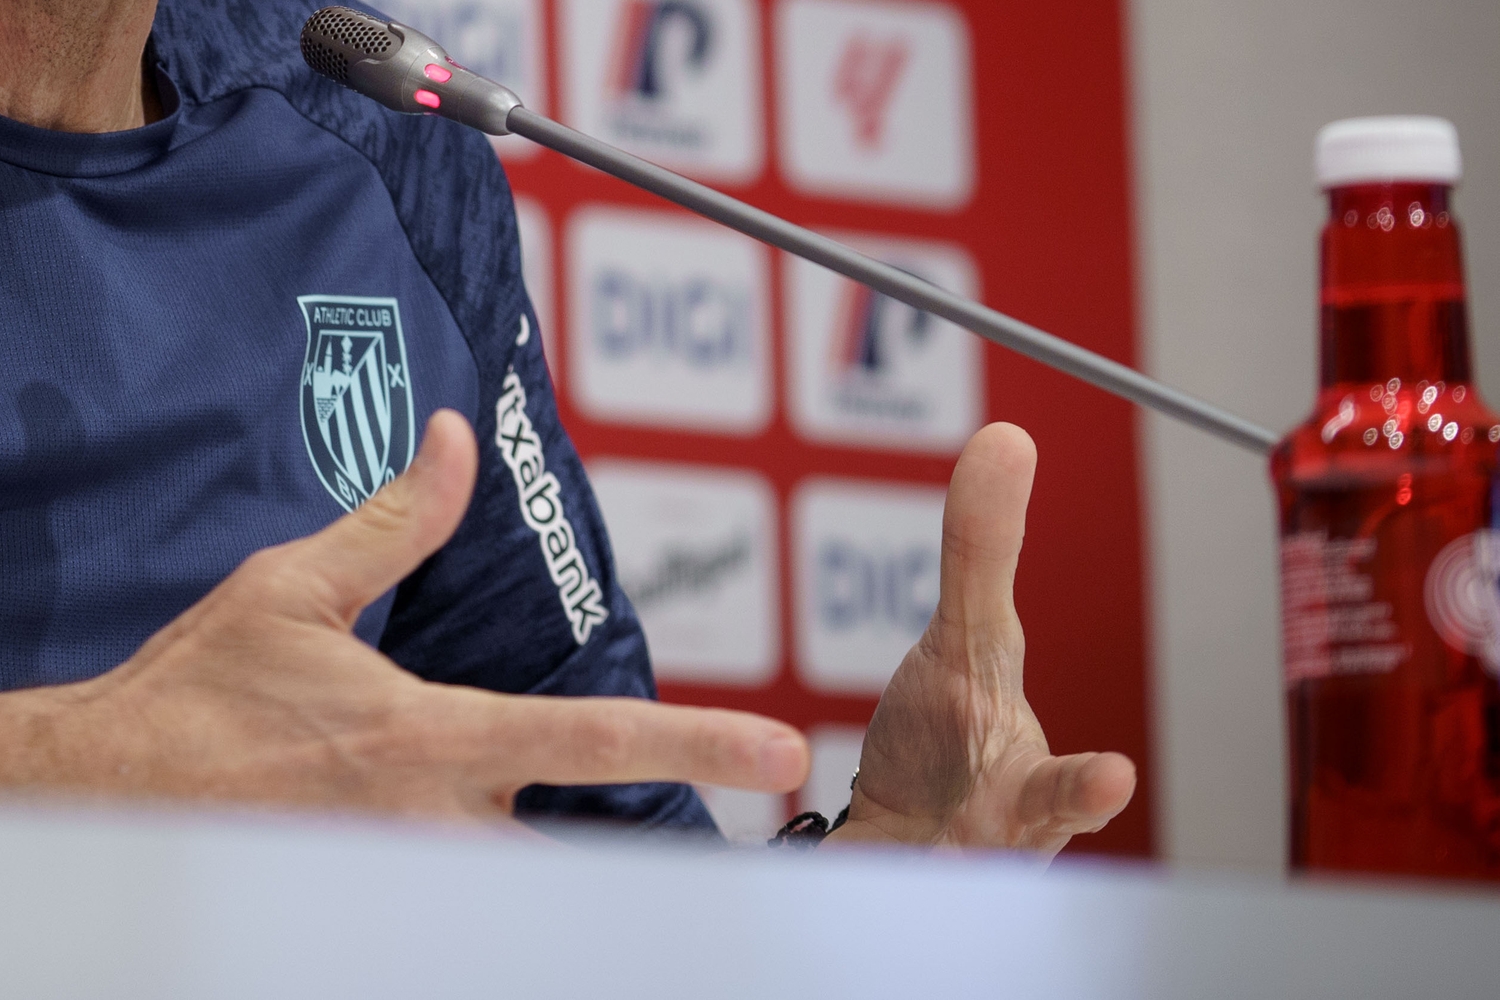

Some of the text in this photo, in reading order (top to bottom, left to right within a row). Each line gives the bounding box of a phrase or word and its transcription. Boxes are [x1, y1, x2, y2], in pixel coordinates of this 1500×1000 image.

[313, 306, 393, 327] ATHLETIC CLUB
[498, 372, 608, 645] txabank
